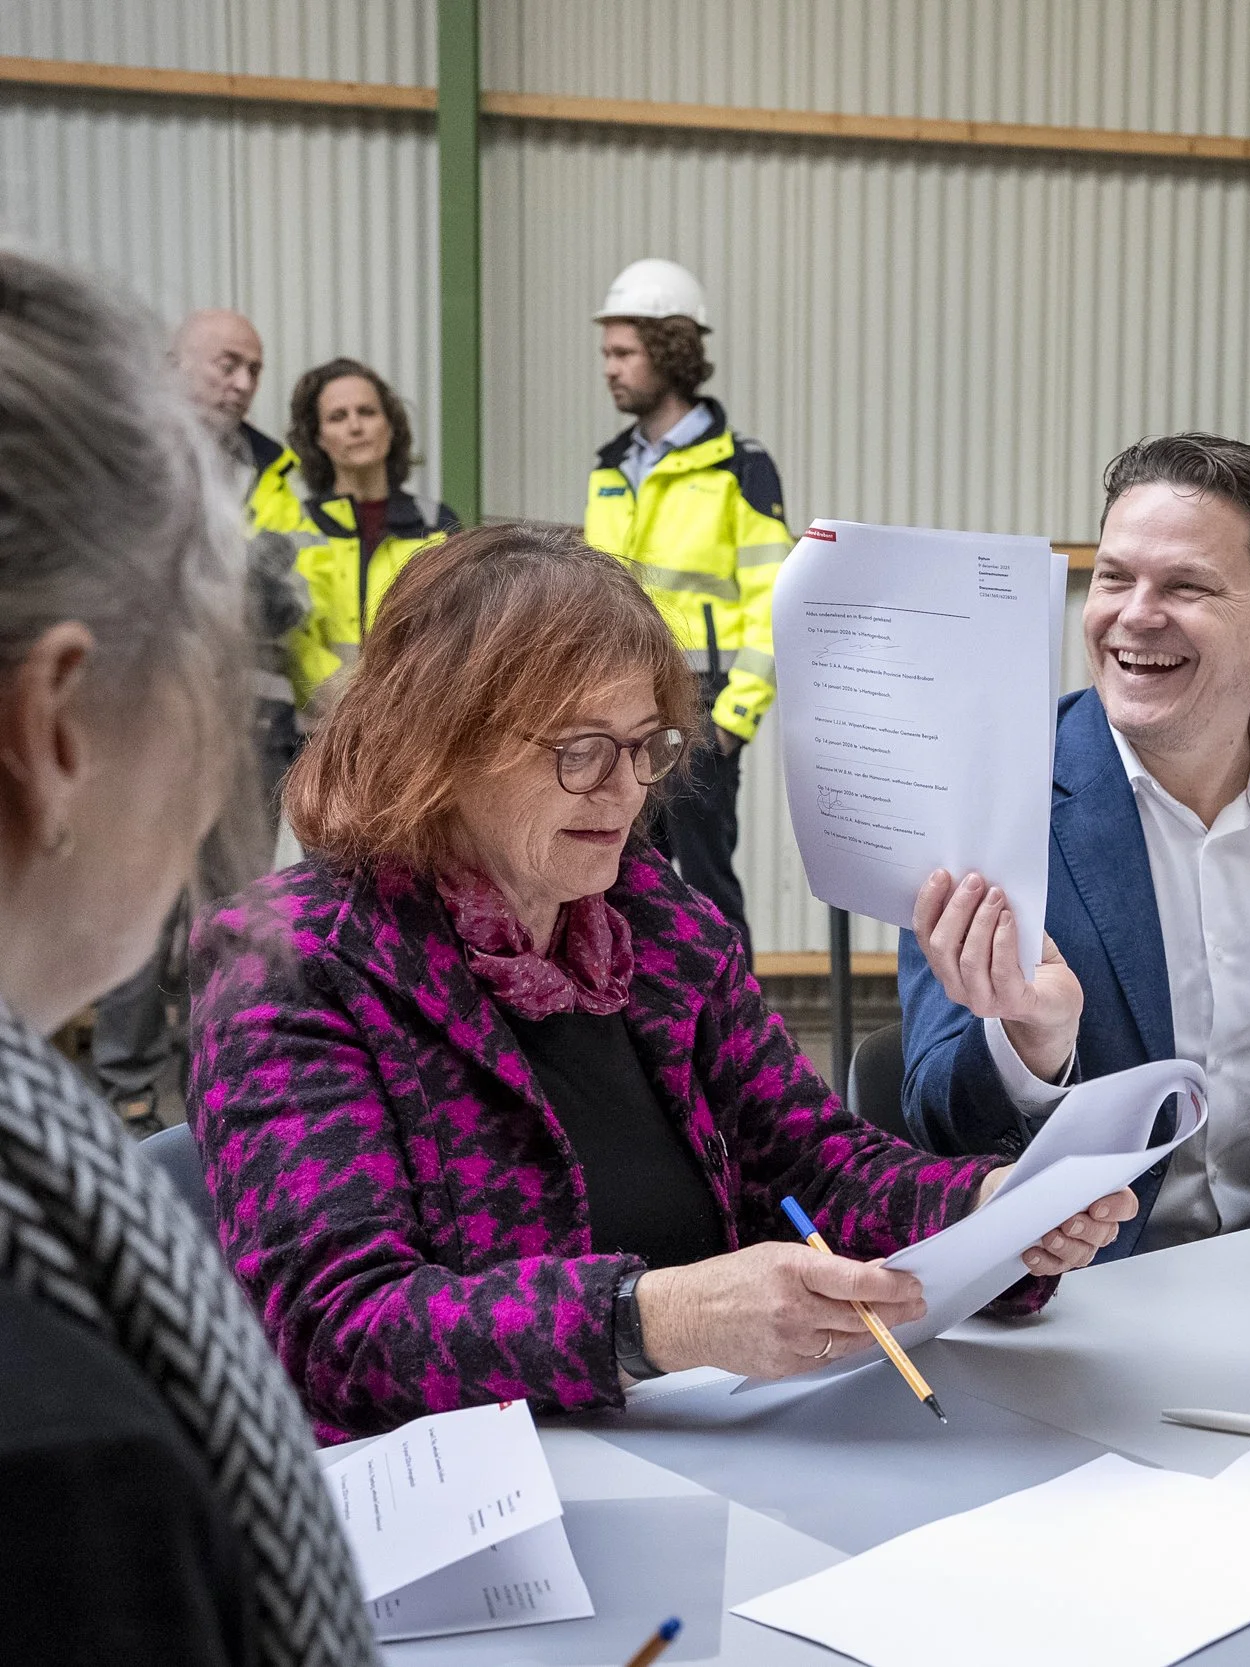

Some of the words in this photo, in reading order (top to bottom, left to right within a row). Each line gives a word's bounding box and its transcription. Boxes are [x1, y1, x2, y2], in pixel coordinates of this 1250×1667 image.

[808, 626, 816, 634] Op
[814, 736, 821, 744] Op
[843, 789, 855, 797] 2026
